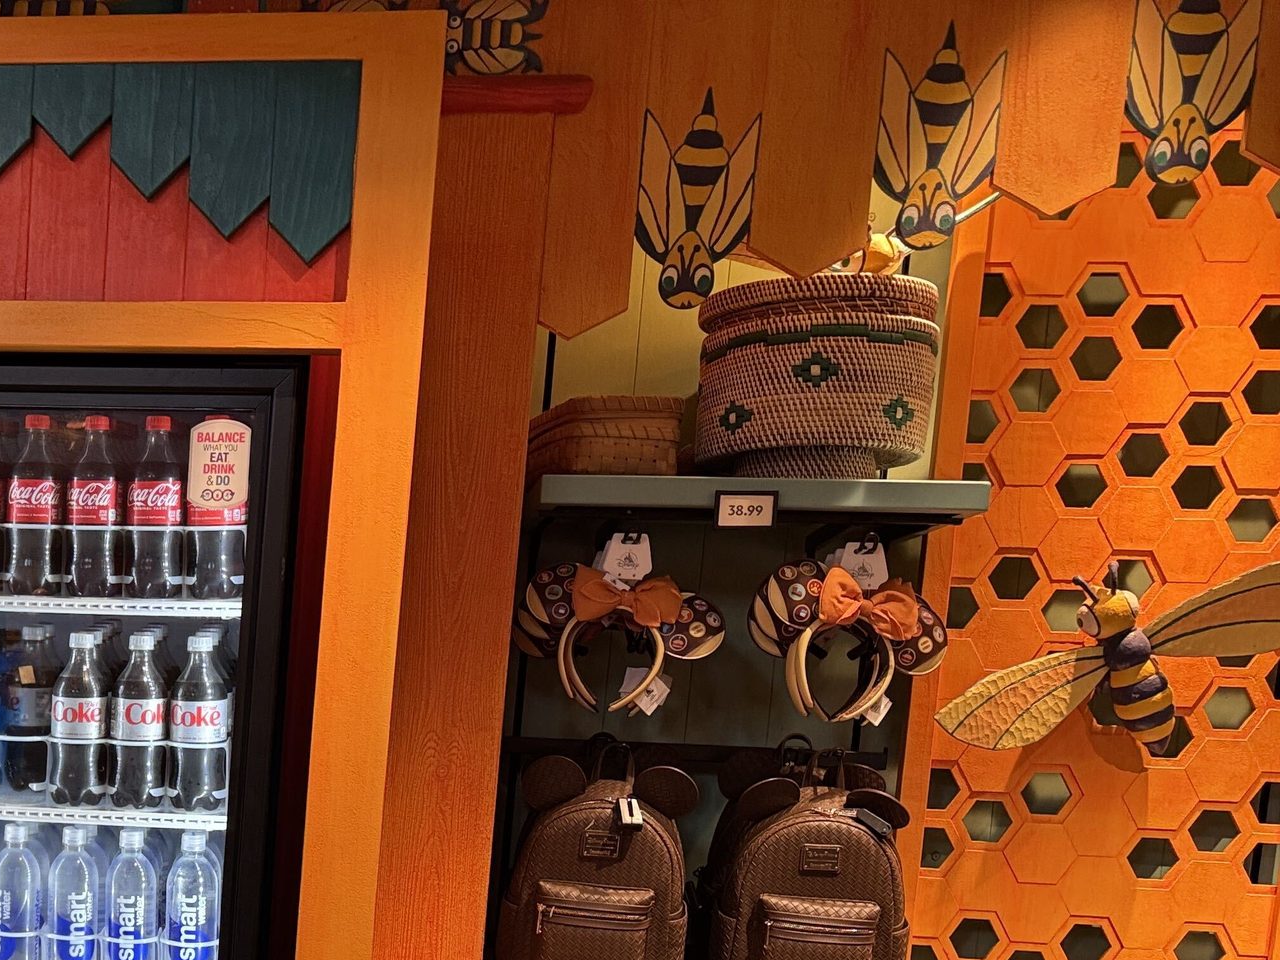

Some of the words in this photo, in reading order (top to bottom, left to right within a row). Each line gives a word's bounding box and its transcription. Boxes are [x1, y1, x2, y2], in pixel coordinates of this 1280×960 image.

[197, 432, 246, 443] BALANCE
[224, 444, 238, 452] YOU
[203, 464, 235, 474] DRINK
[209, 452, 229, 463] EAT
[206, 475, 214, 486] &
[215, 475, 230, 486] DO
[9, 481, 60, 505] Coca-Cola
[728, 504, 763, 516] 38.99
[53, 700, 103, 723] Coke
[171, 704, 221, 727] Coke
[2, 890, 12, 920] water
[135, 895, 145, 926] water
[197, 896, 207, 926] water
[68, 891, 86, 958] smart
